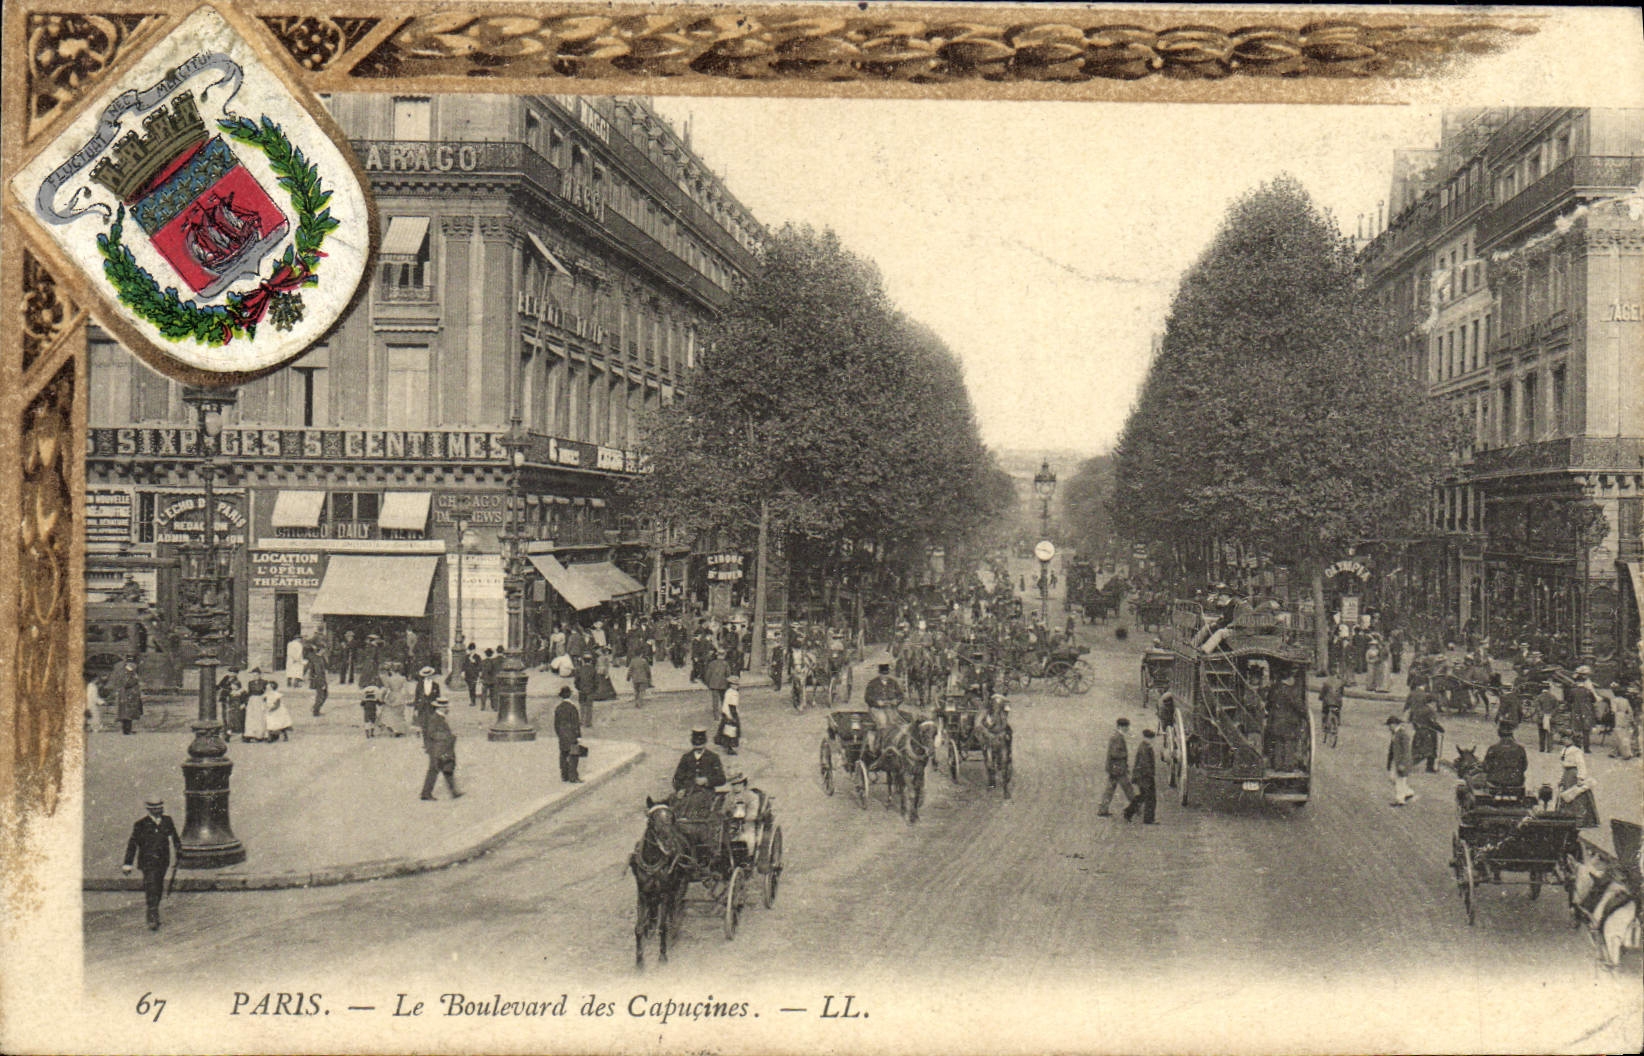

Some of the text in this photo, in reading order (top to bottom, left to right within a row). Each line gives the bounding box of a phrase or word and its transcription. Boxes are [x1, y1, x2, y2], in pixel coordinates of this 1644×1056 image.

[180, 430, 281, 457] PGES
[345, 432, 508, 459] CENTIMES
[438, 494, 502, 508] CHCAGO
[157, 498, 194, 526] L'ECHO
[216, 502, 247, 528] PARIS
[337, 523, 370, 538] DAILY
[252, 553, 319, 564] LOCATION
